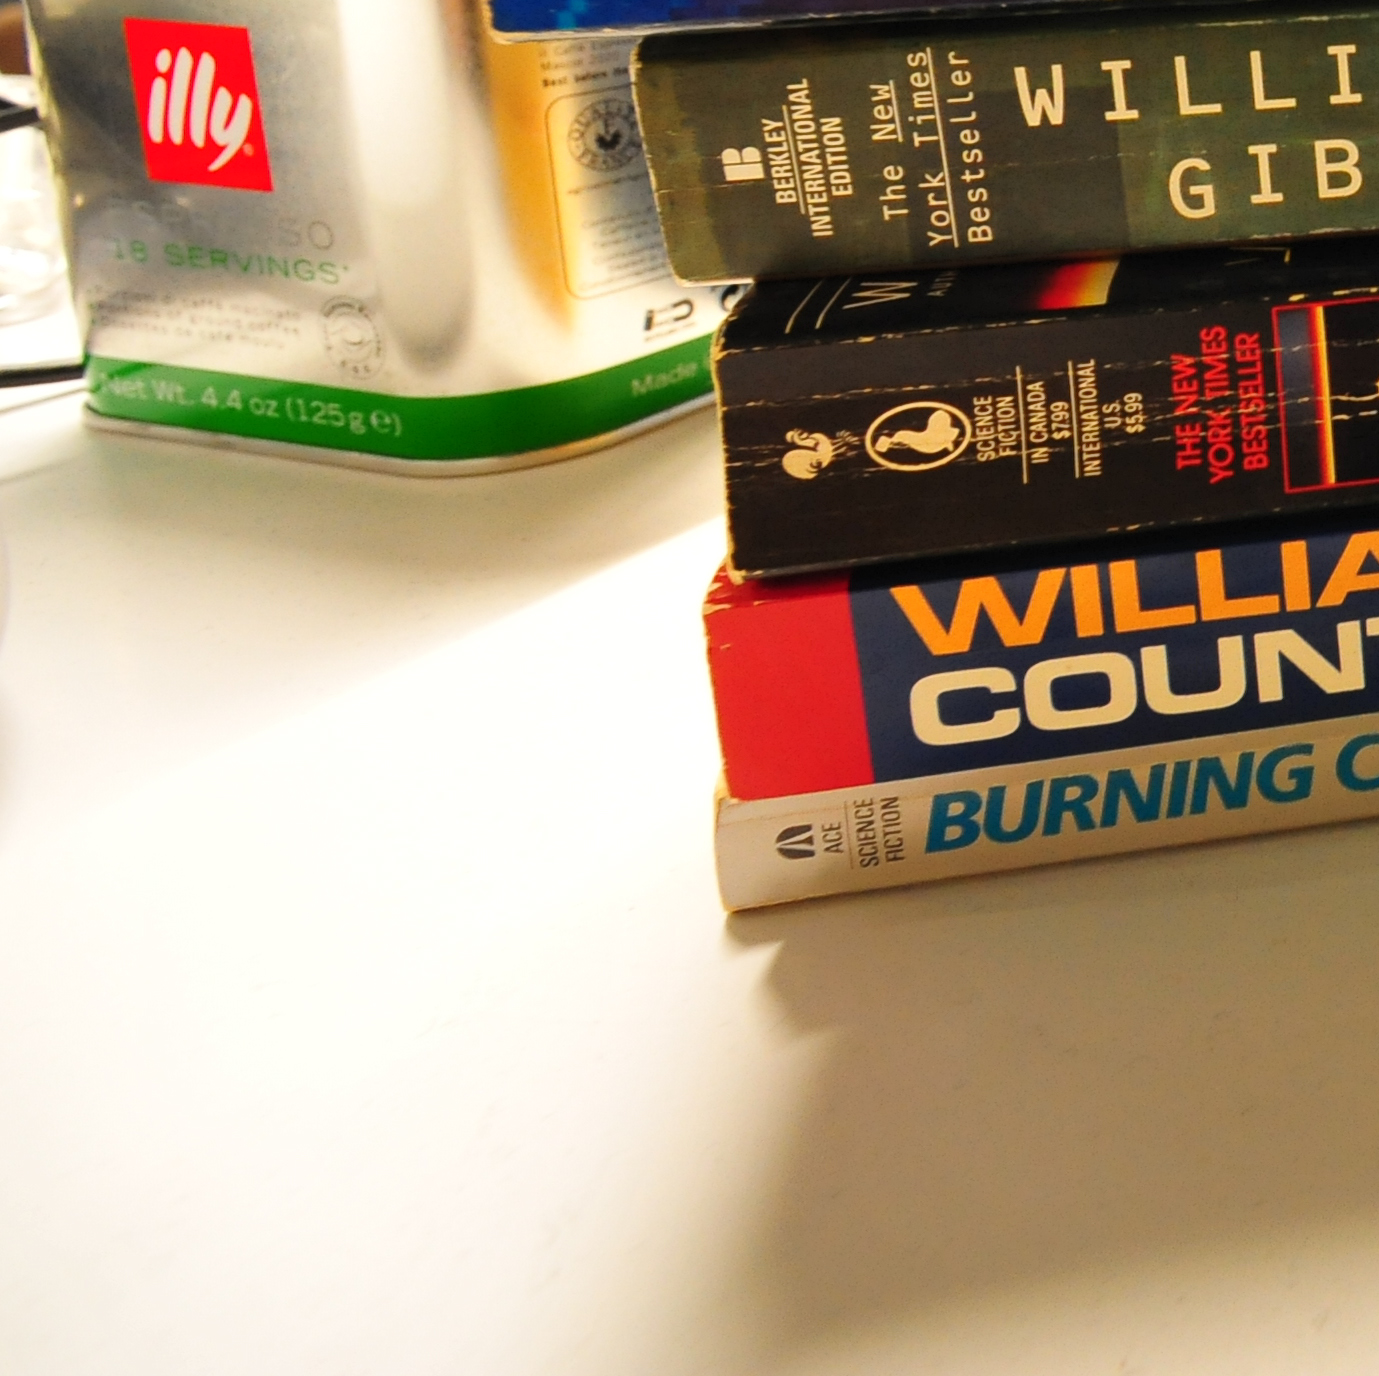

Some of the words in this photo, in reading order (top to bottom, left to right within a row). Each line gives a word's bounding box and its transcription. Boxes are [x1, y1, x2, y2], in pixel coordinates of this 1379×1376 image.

[148, 47, 252, 172] illy
[871, 83, 897, 142] New
[906, 50, 943, 148] Times
[761, 117, 797, 205] BERKLEY
[786, 77, 833, 238] INTERNATIONAL
[826, 115, 854, 197] EDITION
[947, 49, 994, 245] Bestseller
[881, 164, 910, 221] The
[918, 171, 953, 249] York
[113, 238, 148, 264] 18
[1169, 353, 1200, 414] NEW
[1200, 324, 1230, 400] TIMES
[249, 397, 279, 418] oz
[973, 395, 996, 462] SCIENCE
[996, 396, 1017, 456] FICTION
[1026, 381, 1049, 443] CANADA
[1077, 359, 1103, 477] INTERNATIONAL
[1102, 400, 1122, 428] U.S.
[1124, 392, 1146, 434] $5.99
[1234, 331, 1269, 471] BESTSELLER
[1030, 447, 1050, 464] IN
[1174, 422, 1202, 471] THE
[1206, 405, 1235, 485] YORK
[885, 795, 905, 862] FICTION
[925, 742, 1315, 855] BURNING
[824, 821, 843, 854] ACE
[860, 797, 880, 869] SCIENCE
